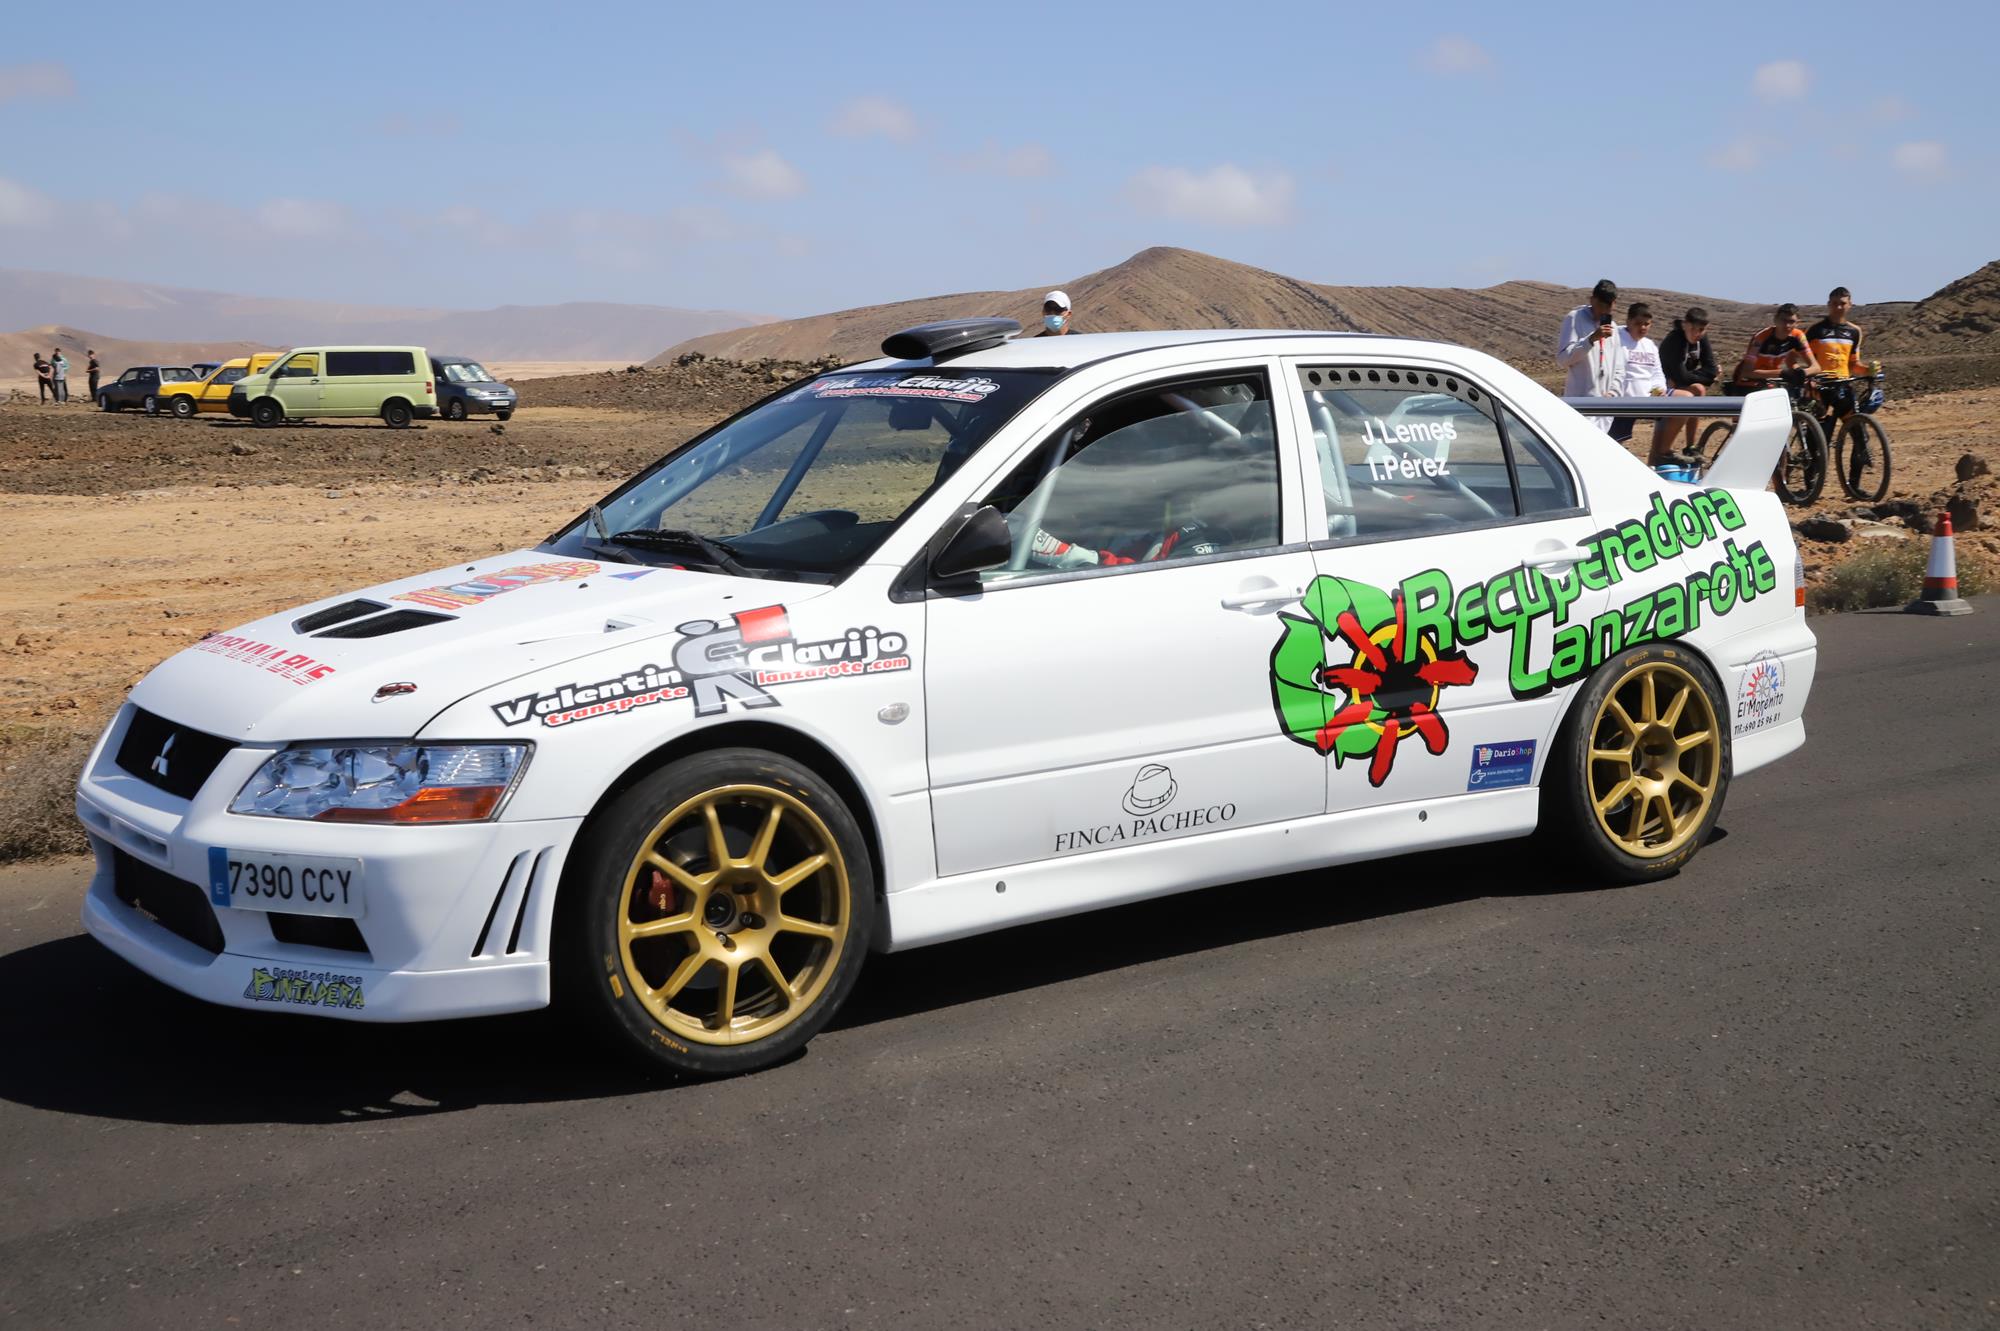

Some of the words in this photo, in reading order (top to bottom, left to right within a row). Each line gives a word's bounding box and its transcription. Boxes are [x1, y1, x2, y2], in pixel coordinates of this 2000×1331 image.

[898, 378, 996, 393] Clavijo
[1361, 418, 1458, 446] J.Lemes
[1368, 452, 1450, 481] I.Pérez
[1399, 487, 1746, 664] Recuperadora
[1508, 538, 1777, 699] Lanzarote
[494, 665, 685, 726] Valentin
[746, 626, 905, 669] Clavijo
[543, 687, 689, 726] transporte
[1737, 702, 1746, 718] El
[1747, 693, 1784, 716] Morenito
[1055, 823, 1126, 852] FINCA
[1132, 803, 1236, 838] PACHECO
[228, 860, 293, 900] 7390
[301, 867, 352, 904] CCY
